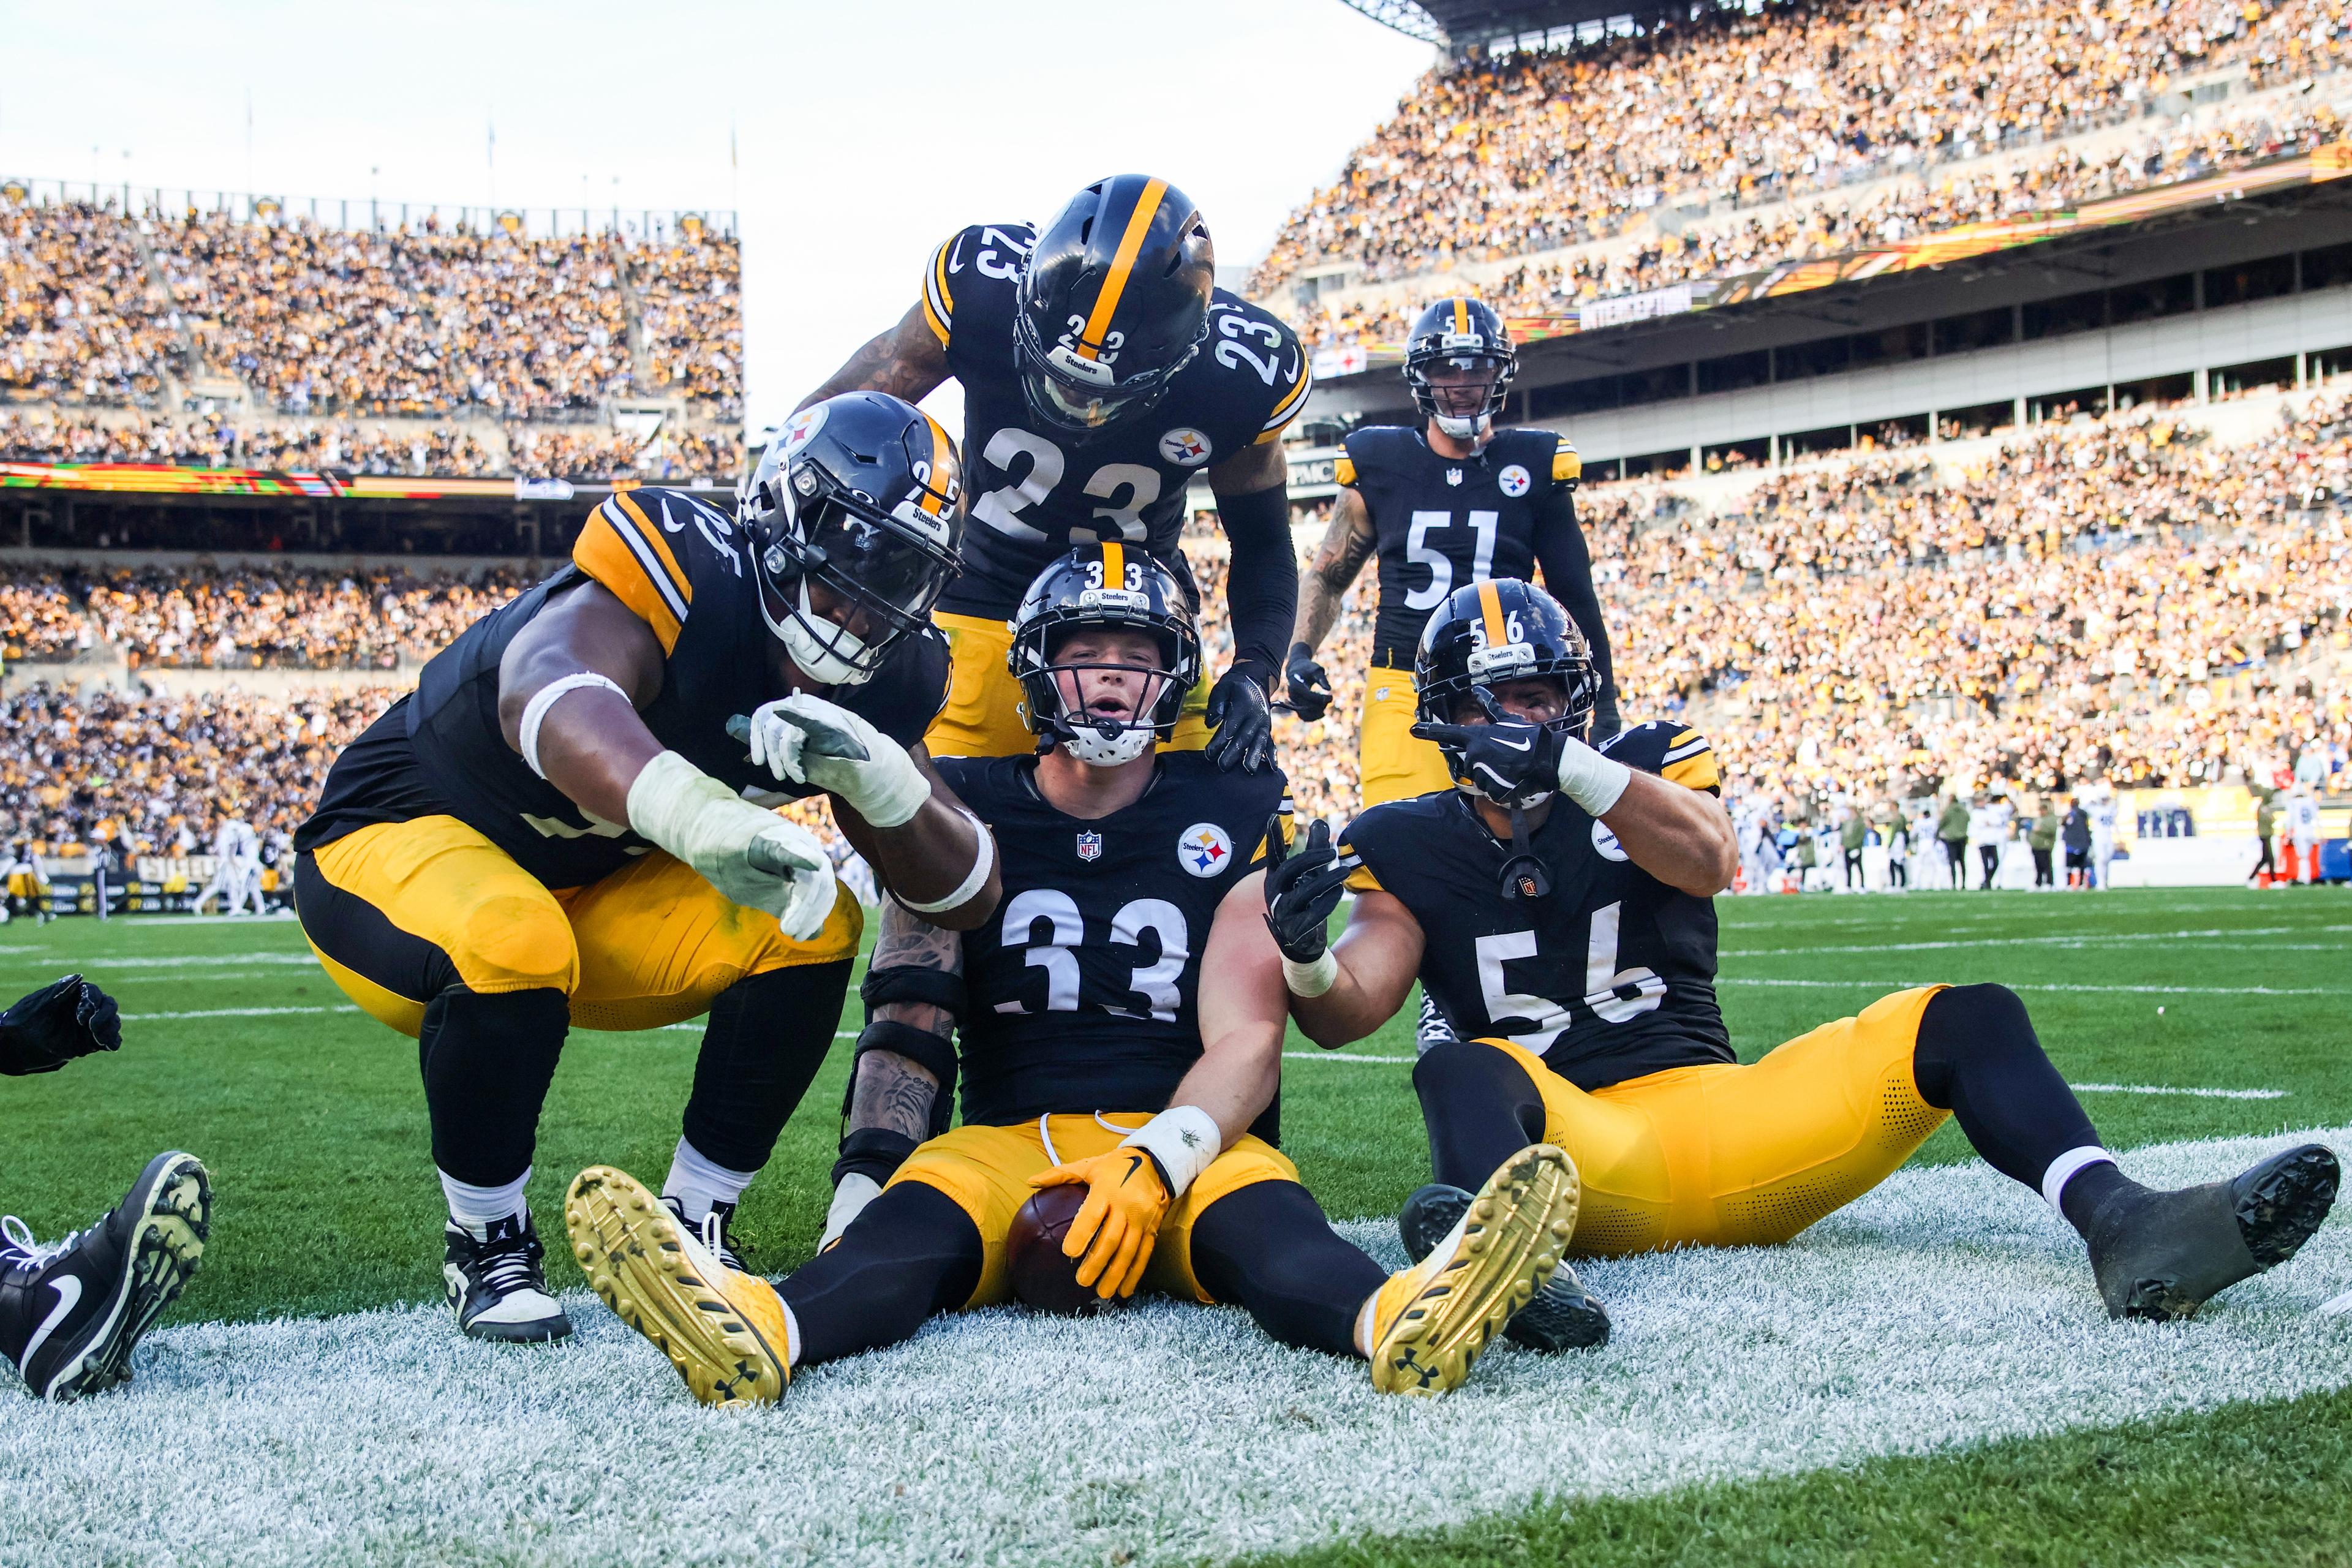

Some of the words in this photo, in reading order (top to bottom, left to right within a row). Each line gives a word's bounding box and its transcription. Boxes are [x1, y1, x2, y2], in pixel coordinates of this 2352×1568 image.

[1058, 314, 1125, 364] 23
[1446, 314, 1475, 336] 51
[1215, 314, 1281, 386] 23
[1066, 355, 1097, 374] Steelers
[1164, 439, 1185, 448] Steelers
[905, 461, 959, 521] 95
[971, 428, 1161, 545] 23
[913, 507, 942, 532] Steelers
[1404, 510, 1499, 610] 51
[1085, 560, 1143, 592] 33
[1102, 592, 1128, 601] Steelers
[1470, 610, 1524, 653] 56
[1487, 650, 1513, 661] Steelers
[1080, 845, 1097, 856] NFL
[1183, 842, 1205, 852] Steelers
[1597, 834, 1615, 845] Steeler
[993, 888, 1190, 1023] 33
[1476, 900, 1667, 1057] 56
